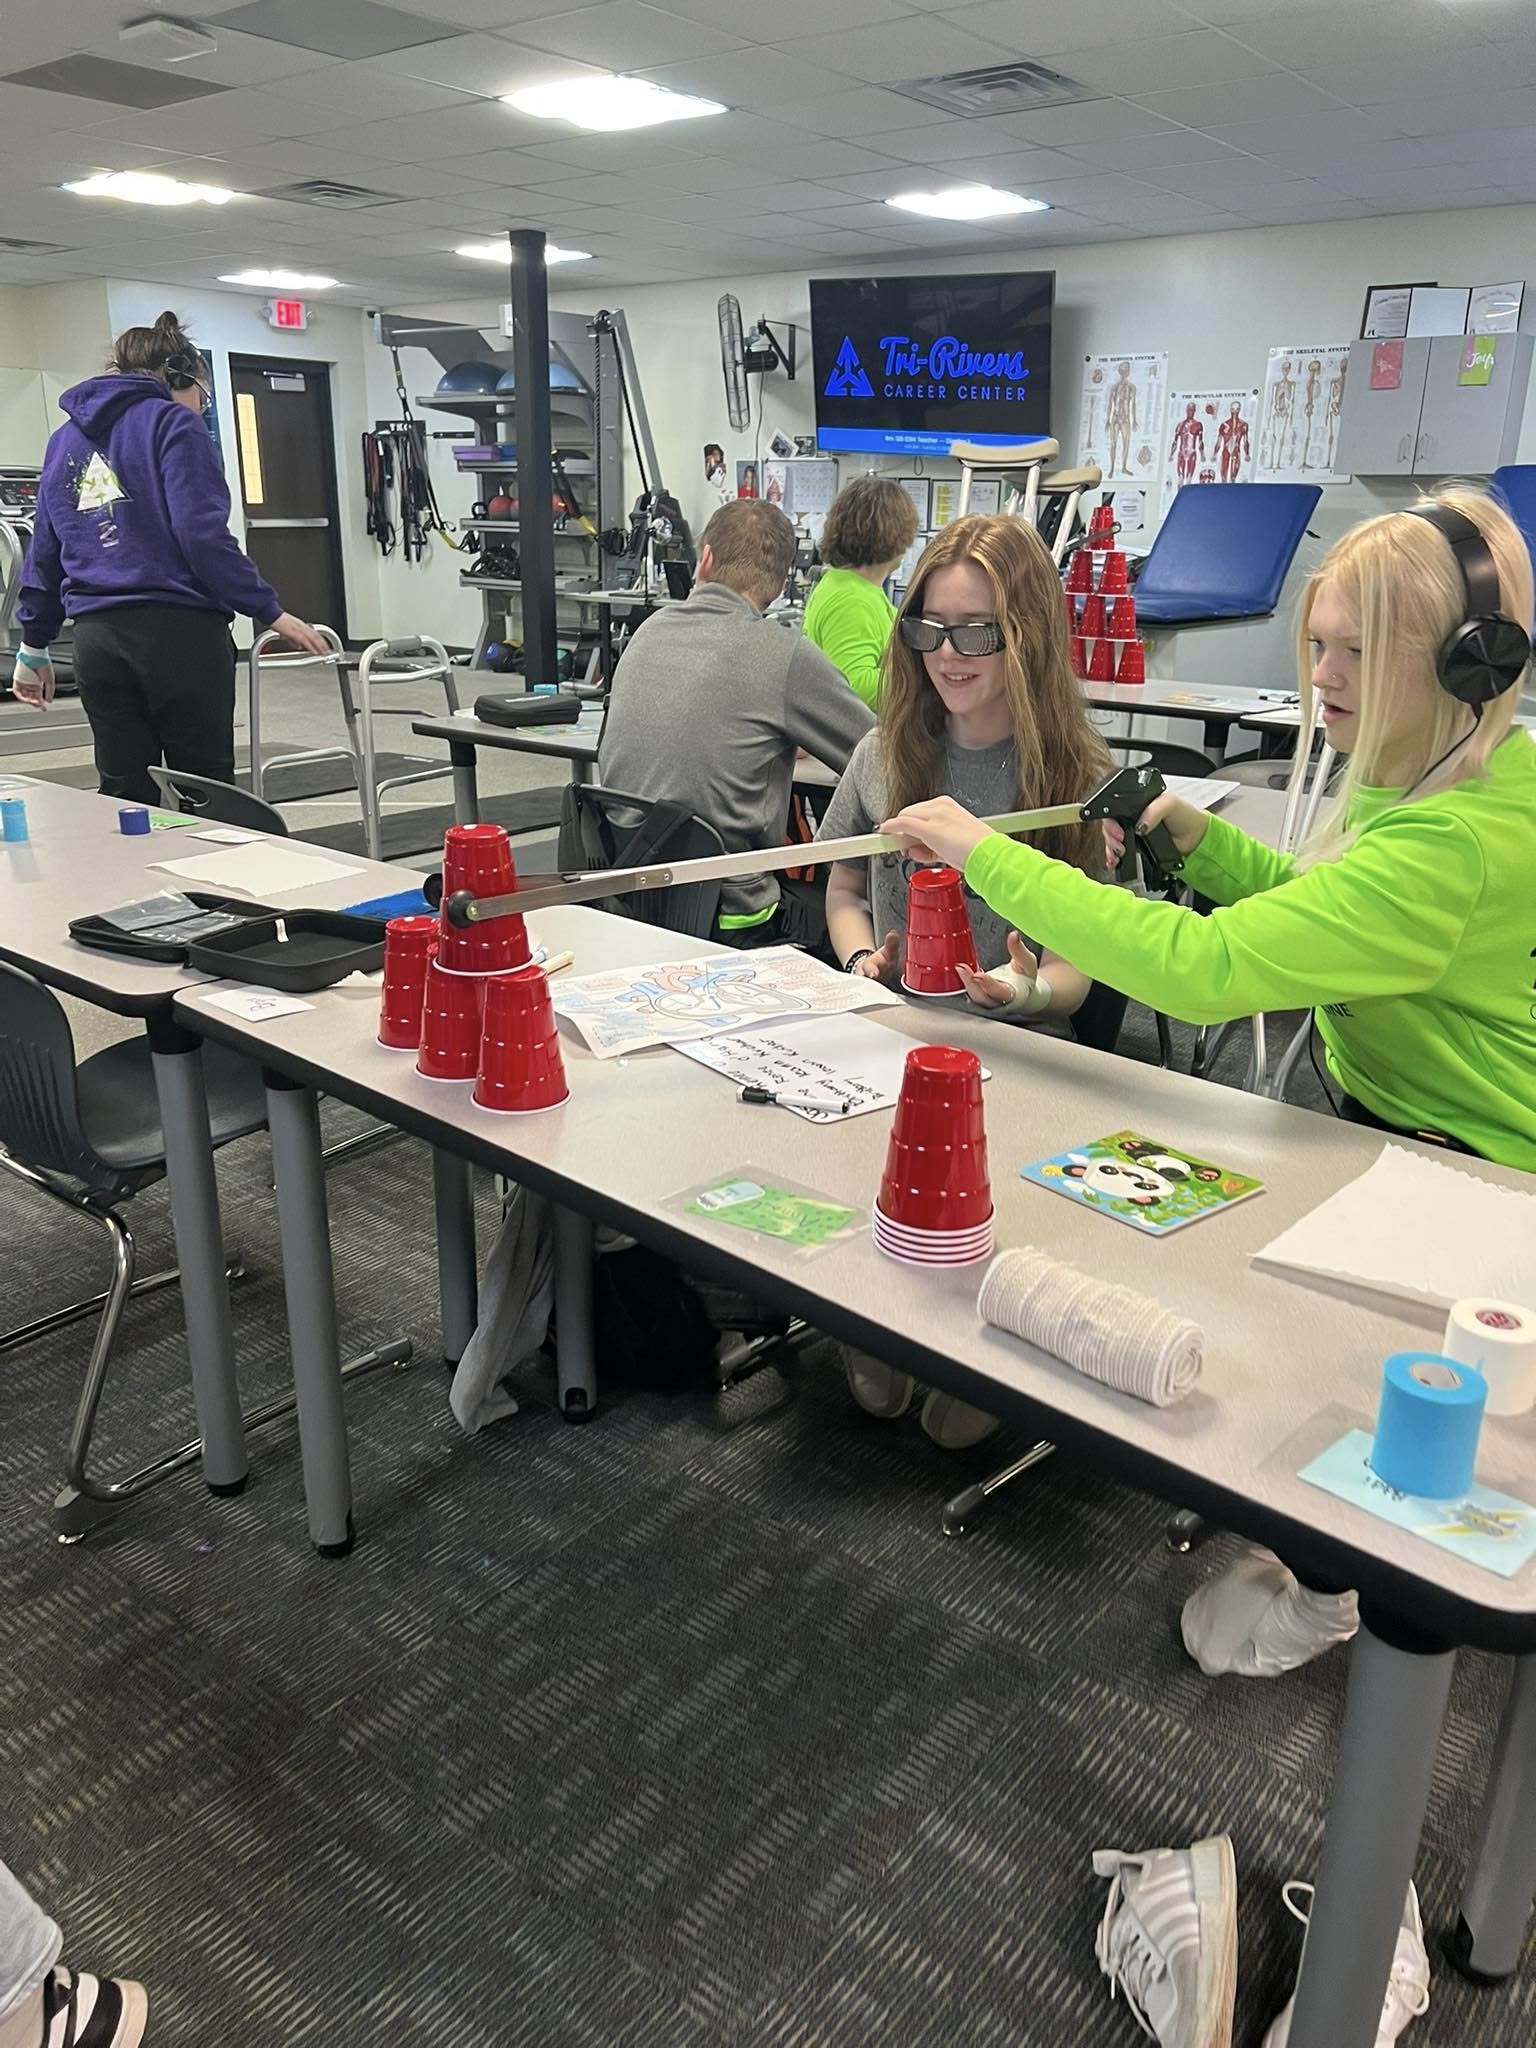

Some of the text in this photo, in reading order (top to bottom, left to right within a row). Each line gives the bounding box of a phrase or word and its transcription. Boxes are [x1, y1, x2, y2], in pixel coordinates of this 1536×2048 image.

[880, 335, 1030, 381] Tri-Rivers
[883, 384, 1026, 401] CAREER CENTER
